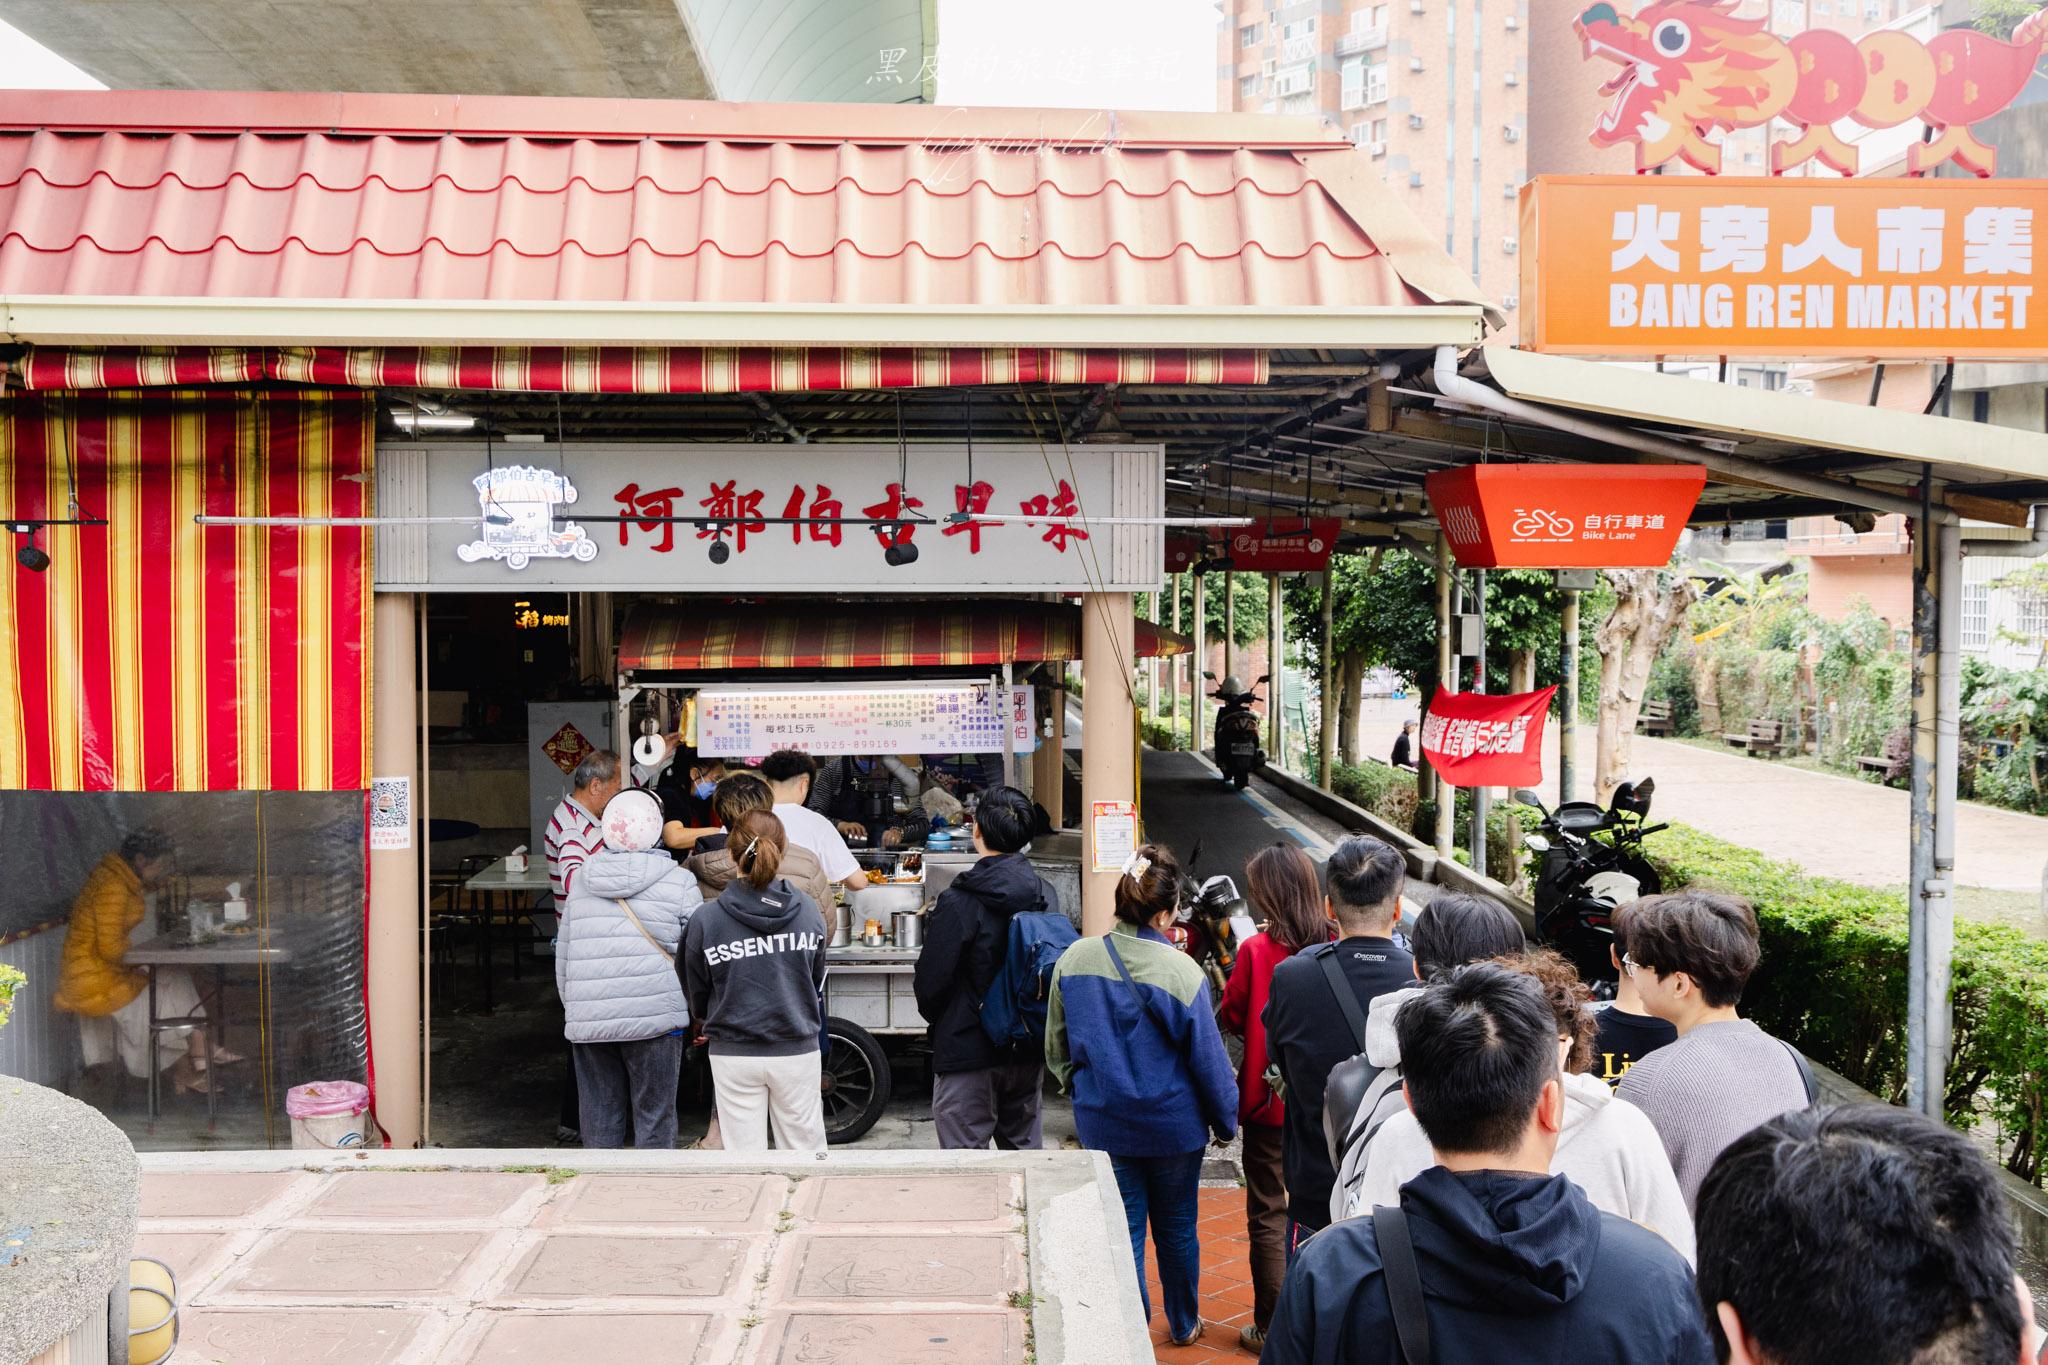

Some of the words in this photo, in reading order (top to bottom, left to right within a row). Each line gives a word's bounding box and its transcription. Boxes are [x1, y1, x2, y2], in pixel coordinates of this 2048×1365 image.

[1609, 284, 1733, 328] BANG
[1746, 284, 1833, 328] REN
[1846, 285, 2033, 329] MARKET
[614, 479, 1089, 554] 阿鄭伯古早味
[1584, 514, 1665, 530] 自行車道
[1582, 531, 1606, 540] Bike
[1609, 531, 1636, 540] Lane
[1602, 1053, 1637, 1078] Li
